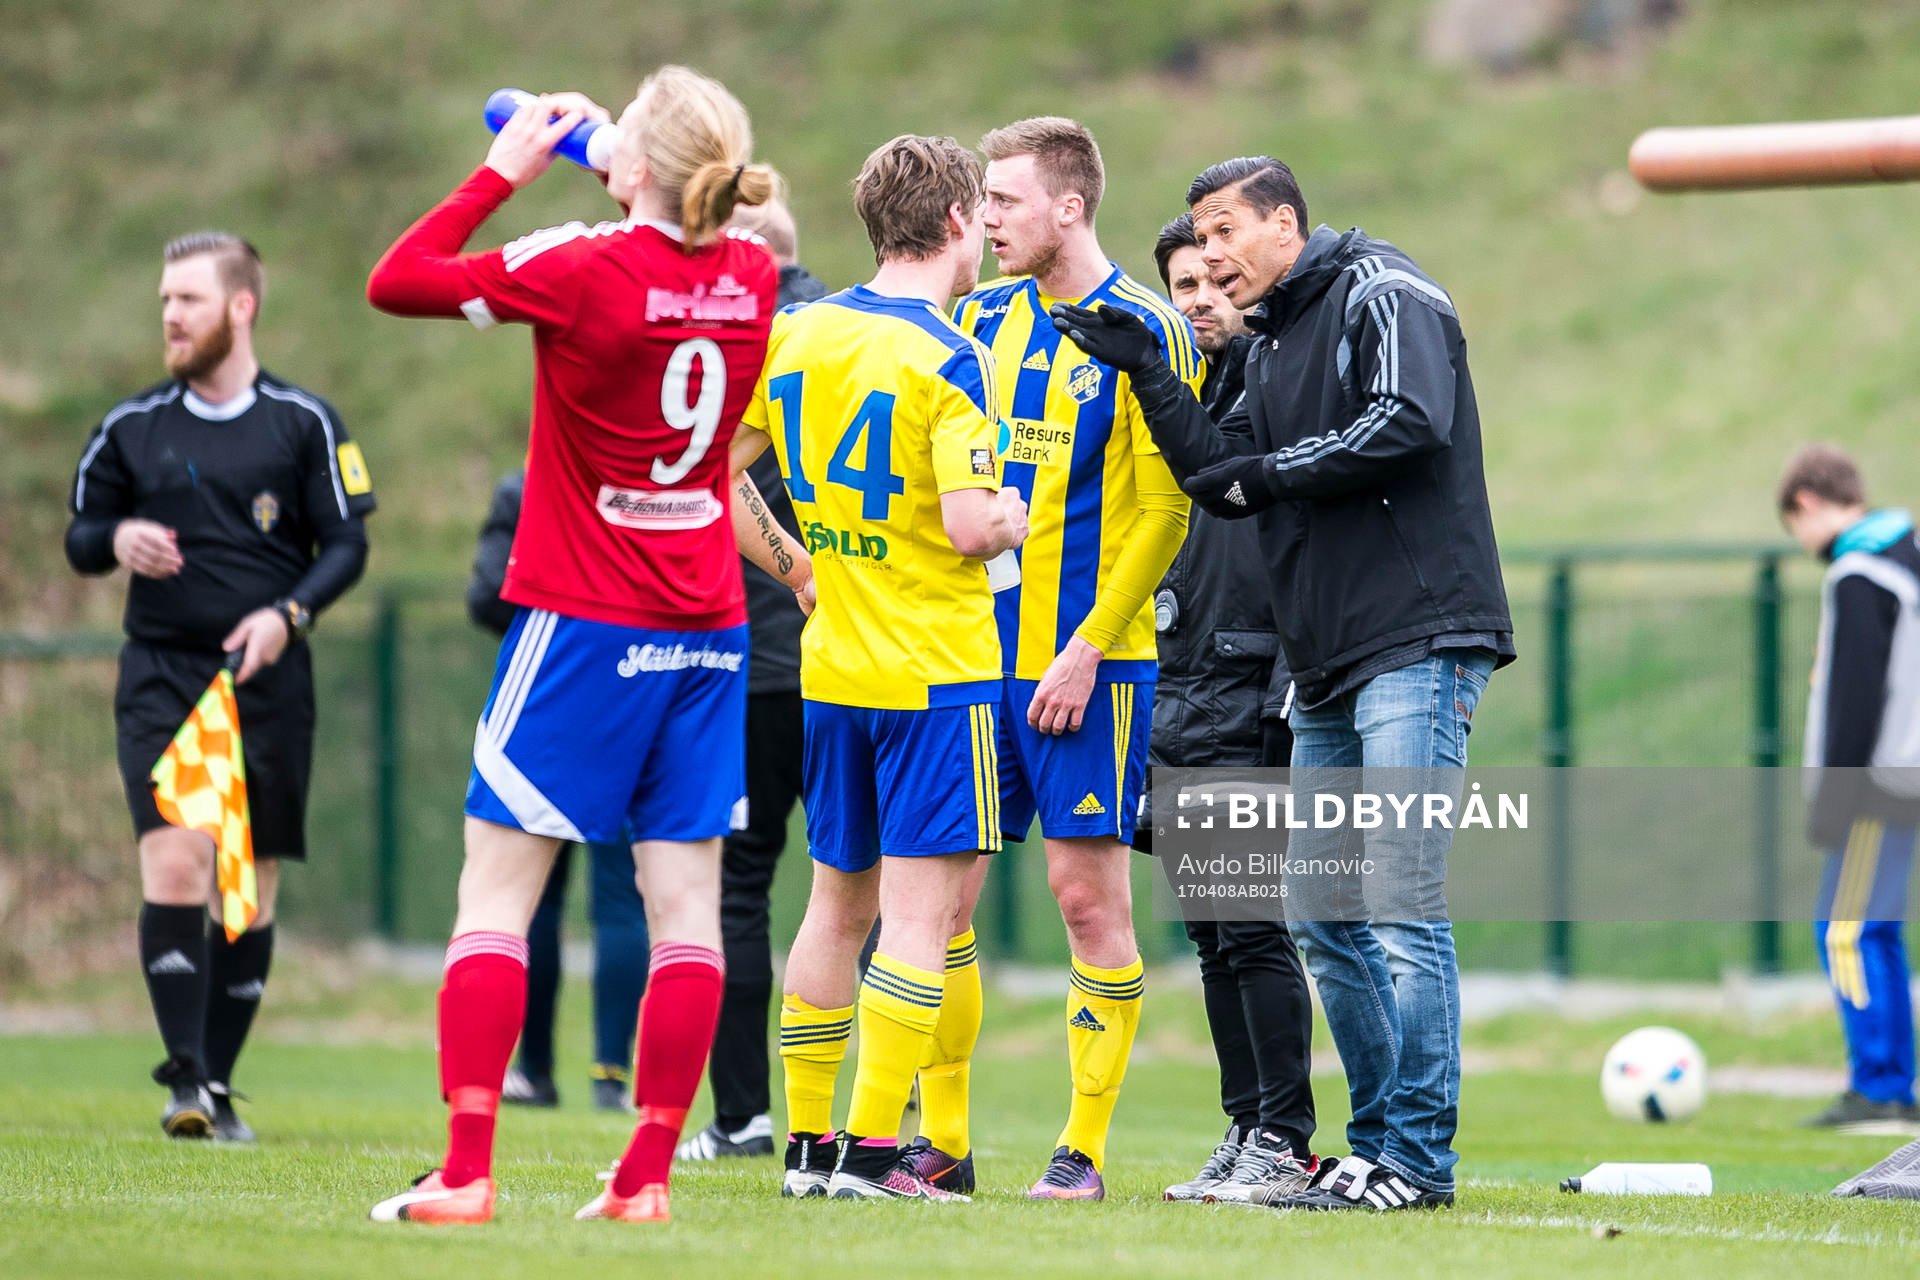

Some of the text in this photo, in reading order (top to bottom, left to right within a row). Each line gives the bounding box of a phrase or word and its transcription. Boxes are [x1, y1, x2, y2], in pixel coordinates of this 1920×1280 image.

[650, 337, 727, 485] 9
[1014, 422, 1071, 445] Resurs
[768, 371, 905, 521] 14
[1012, 441, 1051, 462] Bank
[1069, 1018, 1106, 1032] adidas
